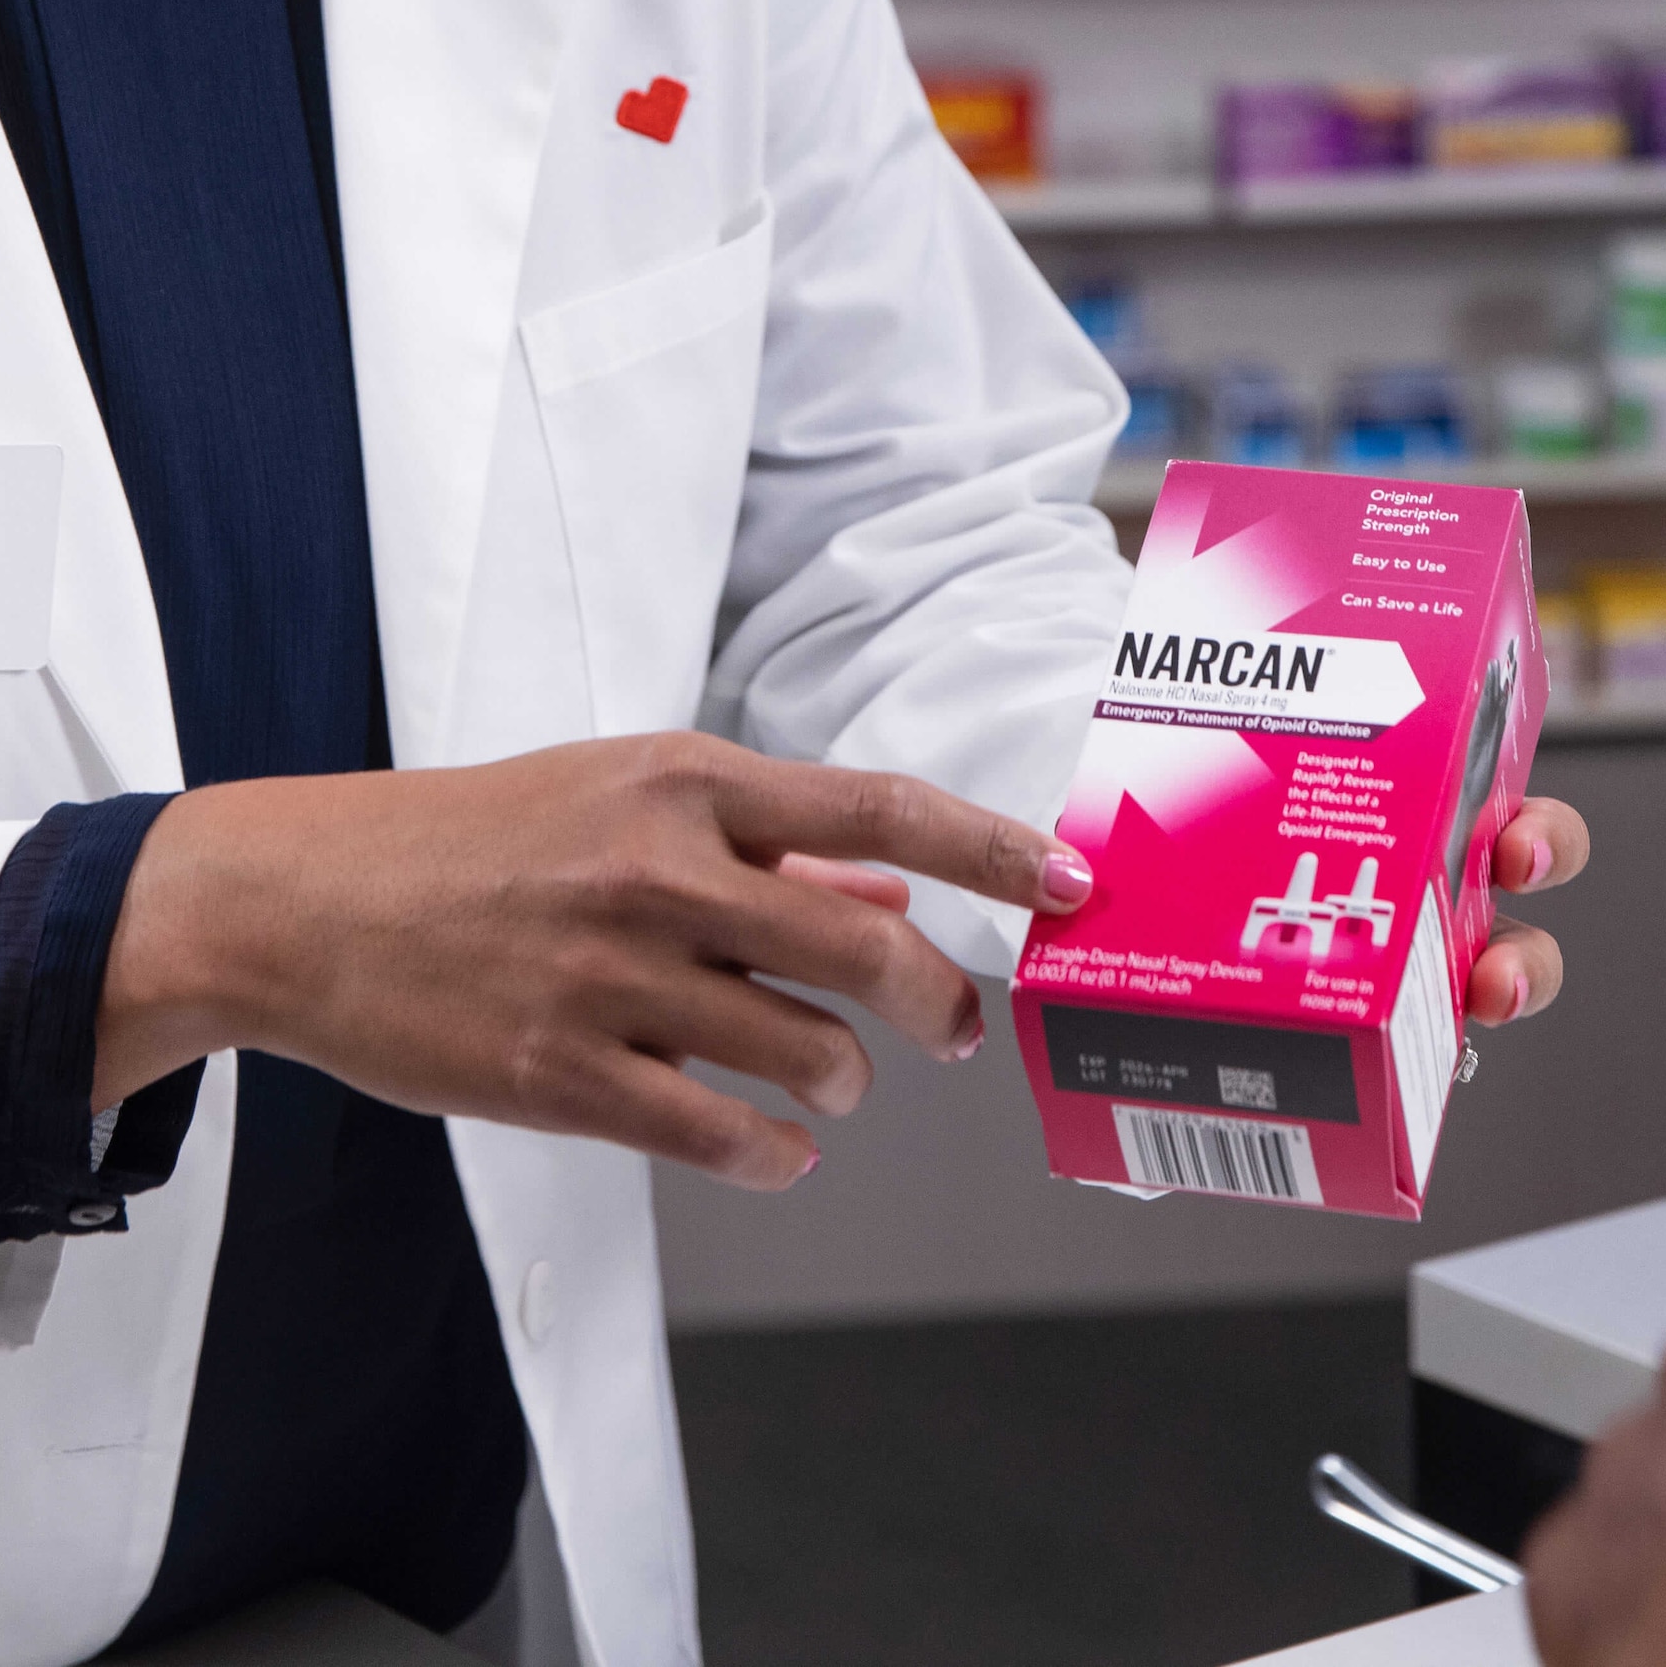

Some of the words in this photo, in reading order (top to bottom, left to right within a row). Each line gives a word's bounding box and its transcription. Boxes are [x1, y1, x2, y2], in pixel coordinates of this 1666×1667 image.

[1370, 489, 1433, 505] Original
[1366, 503, 1459, 522] Prescription
[1361, 518, 1430, 536] Strength
[1352, 553, 1389, 570] Easy
[1394, 558, 1411, 569] to
[1416, 559, 1446, 573] Use
[1341, 593, 1372, 607] Can
[1376, 596, 1415, 611] Save
[1418, 603, 1429, 612] a
[1433, 601, 1463, 617] Life
[1113, 631, 1325, 693] NARCAN
[1108, 680, 1164, 699] Naloxone
[1188, 687, 1223, 703] Nasal
[1224, 690, 1259, 708] Spray
[1260, 694, 1269, 707] 4
[1269, 696, 1288, 711] mg
[1101, 702, 1176, 724] Emergency
[1176, 709, 1244, 728] Treatment
[1244, 715, 1261, 730] of
[1261, 716, 1307, 735] Opioid
[1308, 720, 1372, 739] Overdose
[1296, 750, 1360, 771] Designed
[1360, 757, 1375, 772] to
[1292, 768, 1342, 790] Rapidly
[1342, 772, 1395, 793] Reverse
[1287, 785, 1310, 802] the
[1311, 788, 1354, 806] Effects
[1354, 792, 1371, 807] of
[1370, 796, 1380, 808] a
[1277, 820, 1324, 840] Opioid
[1324, 825, 1397, 850] Emergency
[1029, 942, 1043, 961] 2
[1126, 950, 1168, 973] Nasal
[1167, 955, 1209, 980] Spray
[1208, 959, 1264, 984] Devices
[1158, 977, 1193, 996] each
[1304, 968, 1330, 990] For
[1329, 976, 1359, 994] use
[1358, 977, 1375, 996] in
[1299, 992, 1337, 1013] nose
[1336, 996, 1370, 1020] only
